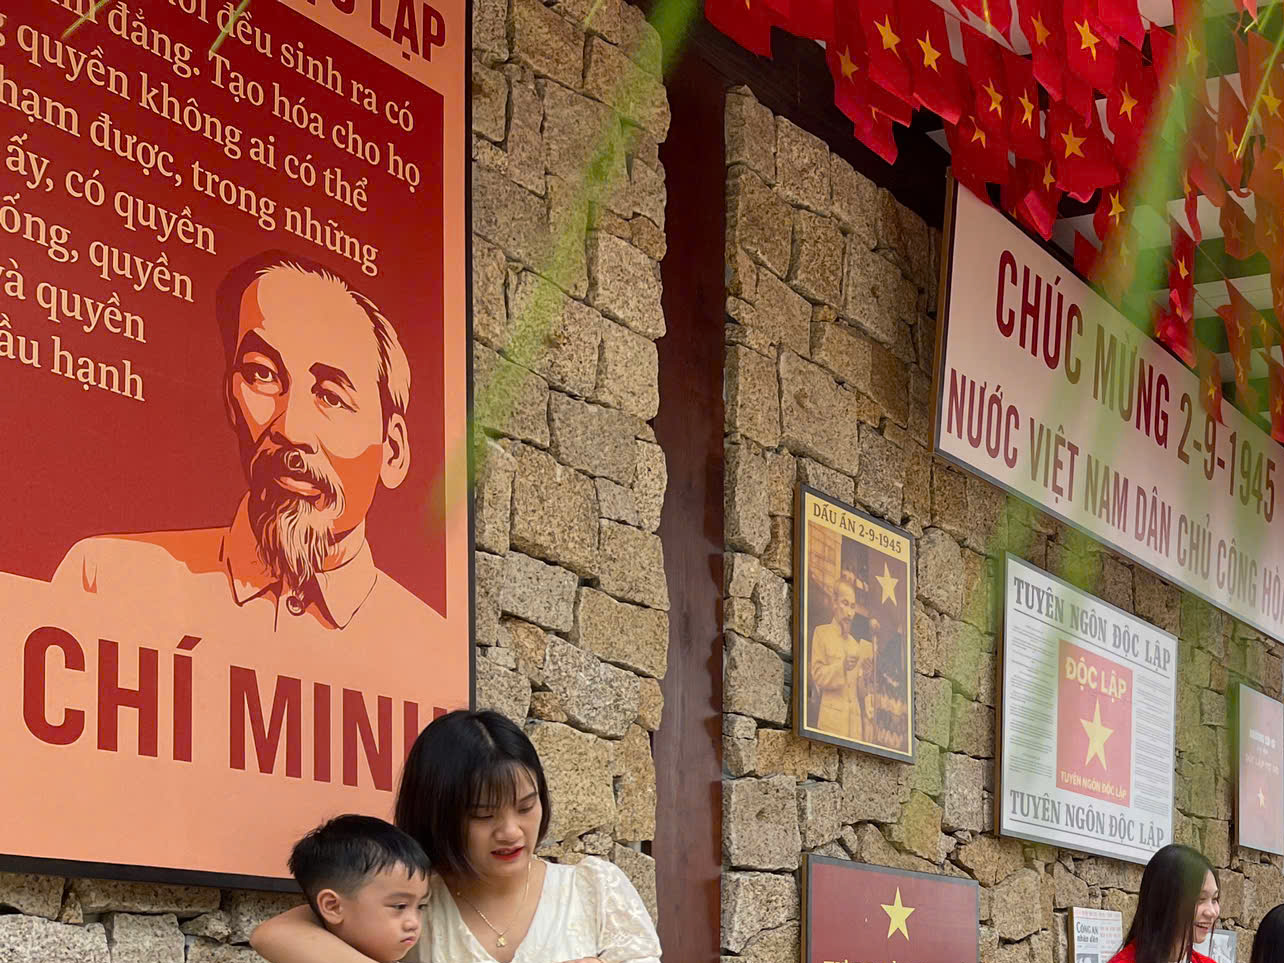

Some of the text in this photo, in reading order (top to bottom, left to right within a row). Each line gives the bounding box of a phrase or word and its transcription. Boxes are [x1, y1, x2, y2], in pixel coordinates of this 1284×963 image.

[17, 25, 130, 100] quyền
[139, 72, 242, 159] không
[250, 136, 276, 170] ai
[284, 154, 316, 186] có
[323, 168, 368, 212] thể
[108, 1, 200, 78] đẳng.
[208, 50, 264, 106] Tạo
[272, 82, 325, 139] hóa
[332, 121, 380, 165] cho
[387, 143, 420, 193] họ
[217, 2, 272, 58] đều
[280, 41, 344, 97] sinh
[350, 80, 378, 114] ra
[385, 101, 414, 132] có
[5, 133, 216, 255] ấy, có quyền
[90, 112, 182, 187] được,
[191, 161, 276, 231] trong
[284, 206, 379, 277] những
[36, 281, 146, 343] quyền
[89, 240, 194, 303] quyền
[51, 336, 145, 402] hạnh
[996, 250, 1083, 384] CHÚC
[1177, 392, 1276, 523] 2-9-1945
[813, 502, 837, 525] DẤU
[859, 524, 902, 553] 2-9-1945
[947, 367, 1019, 469] NƯỚC
[1030, 417, 1079, 503] VIỆT
[1085, 454, 1128, 533] NAM
[1135, 485, 1171, 557] DÂN
[1177, 514, 1211, 580] CHỦ
[1014, 577, 1171, 672] TUYÊN NGÔN ĐỘC LẬP
[1065, 656, 1127, 703] ĐỘC LẬP
[22, 626, 202, 763] CHÍ
[1010, 789, 1164, 850] TUYÊN NGÔN ĐỘC LẬP
